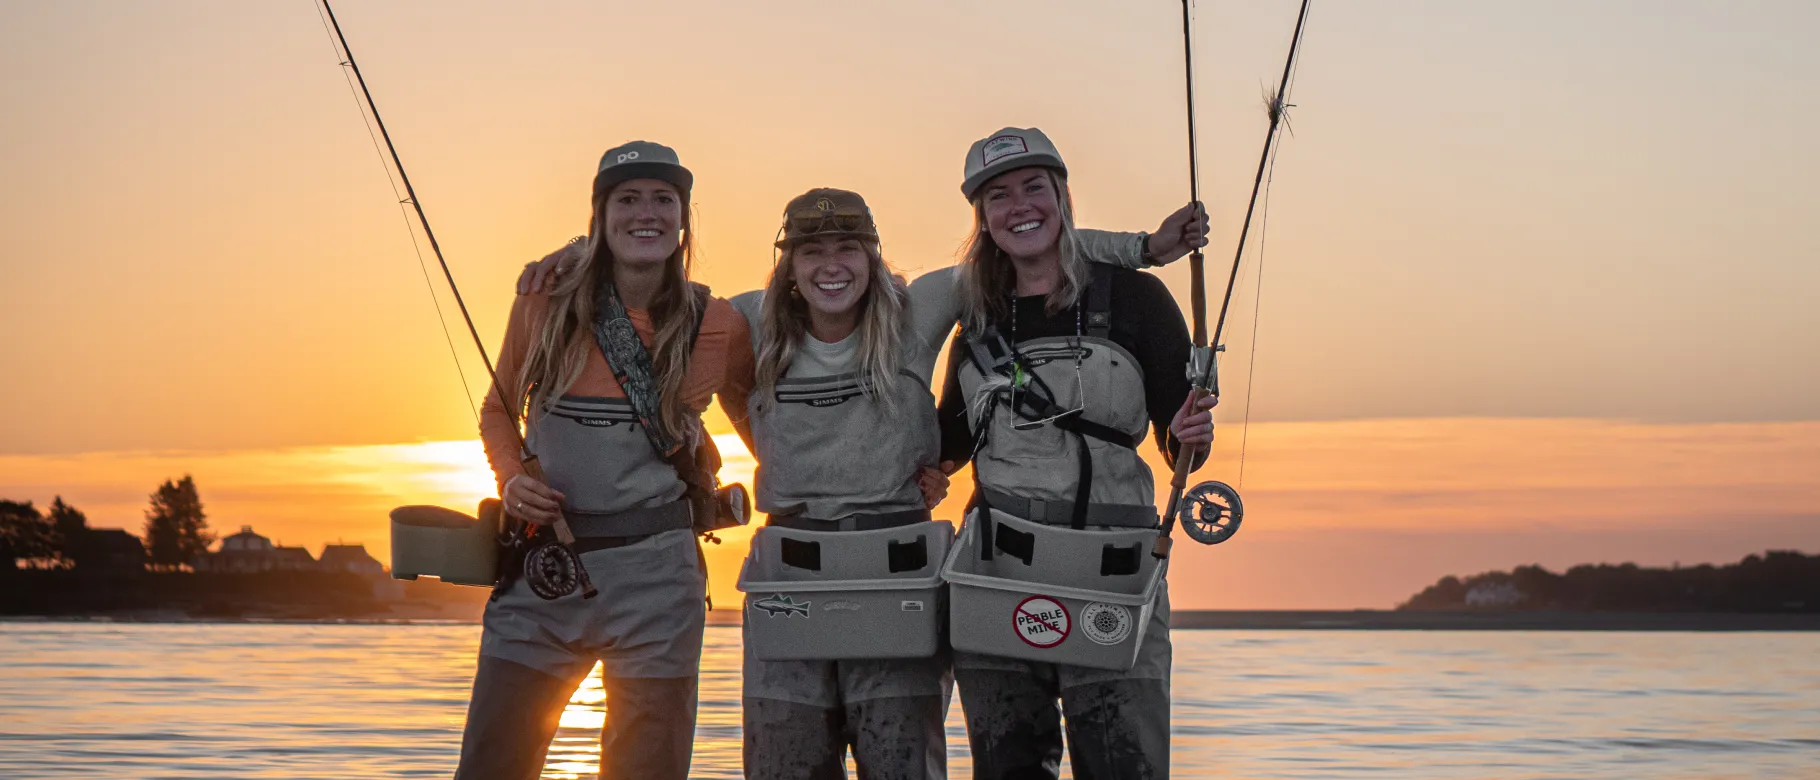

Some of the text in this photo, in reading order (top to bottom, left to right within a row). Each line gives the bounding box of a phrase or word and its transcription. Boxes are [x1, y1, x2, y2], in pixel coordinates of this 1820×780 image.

[617, 151, 639, 164] DO
[812, 397, 843, 406] SIMMS
[581, 418, 612, 426] SIMMS
[1018, 609, 1063, 626] PEBBLE
[1027, 620, 1061, 635] MINE
